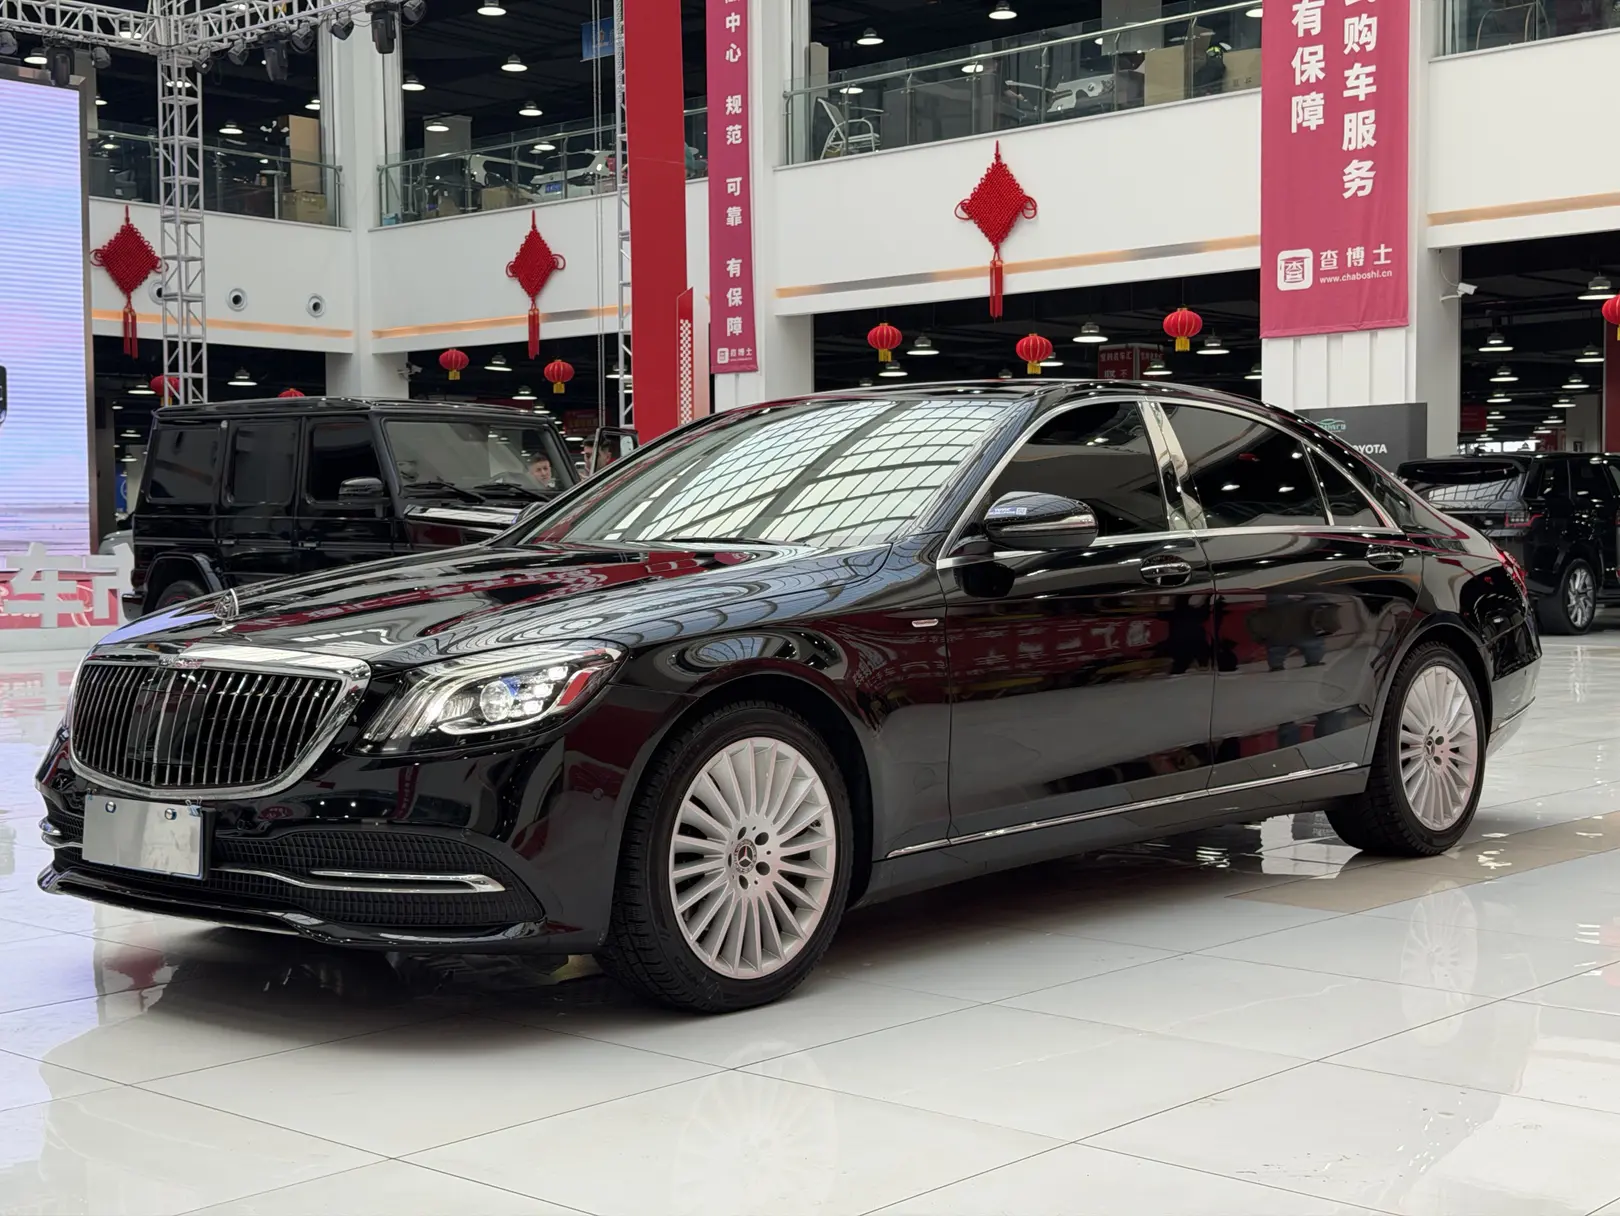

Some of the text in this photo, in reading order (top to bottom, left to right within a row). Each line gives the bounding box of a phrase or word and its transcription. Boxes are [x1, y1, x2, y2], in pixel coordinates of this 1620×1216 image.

[725, 0, 742, 63] 中心
[1291, 0, 1326, 133] 有保障
[725, 94, 743, 145] 规范
[1342, 0, 1378, 199] 购车服务
[725, 176, 743, 227] 可靠
[1319, 243, 1393, 271] 查博士
[1319, 269, 1393, 284] www.chaboshi.cn
[726, 257, 743, 337] 有保障
